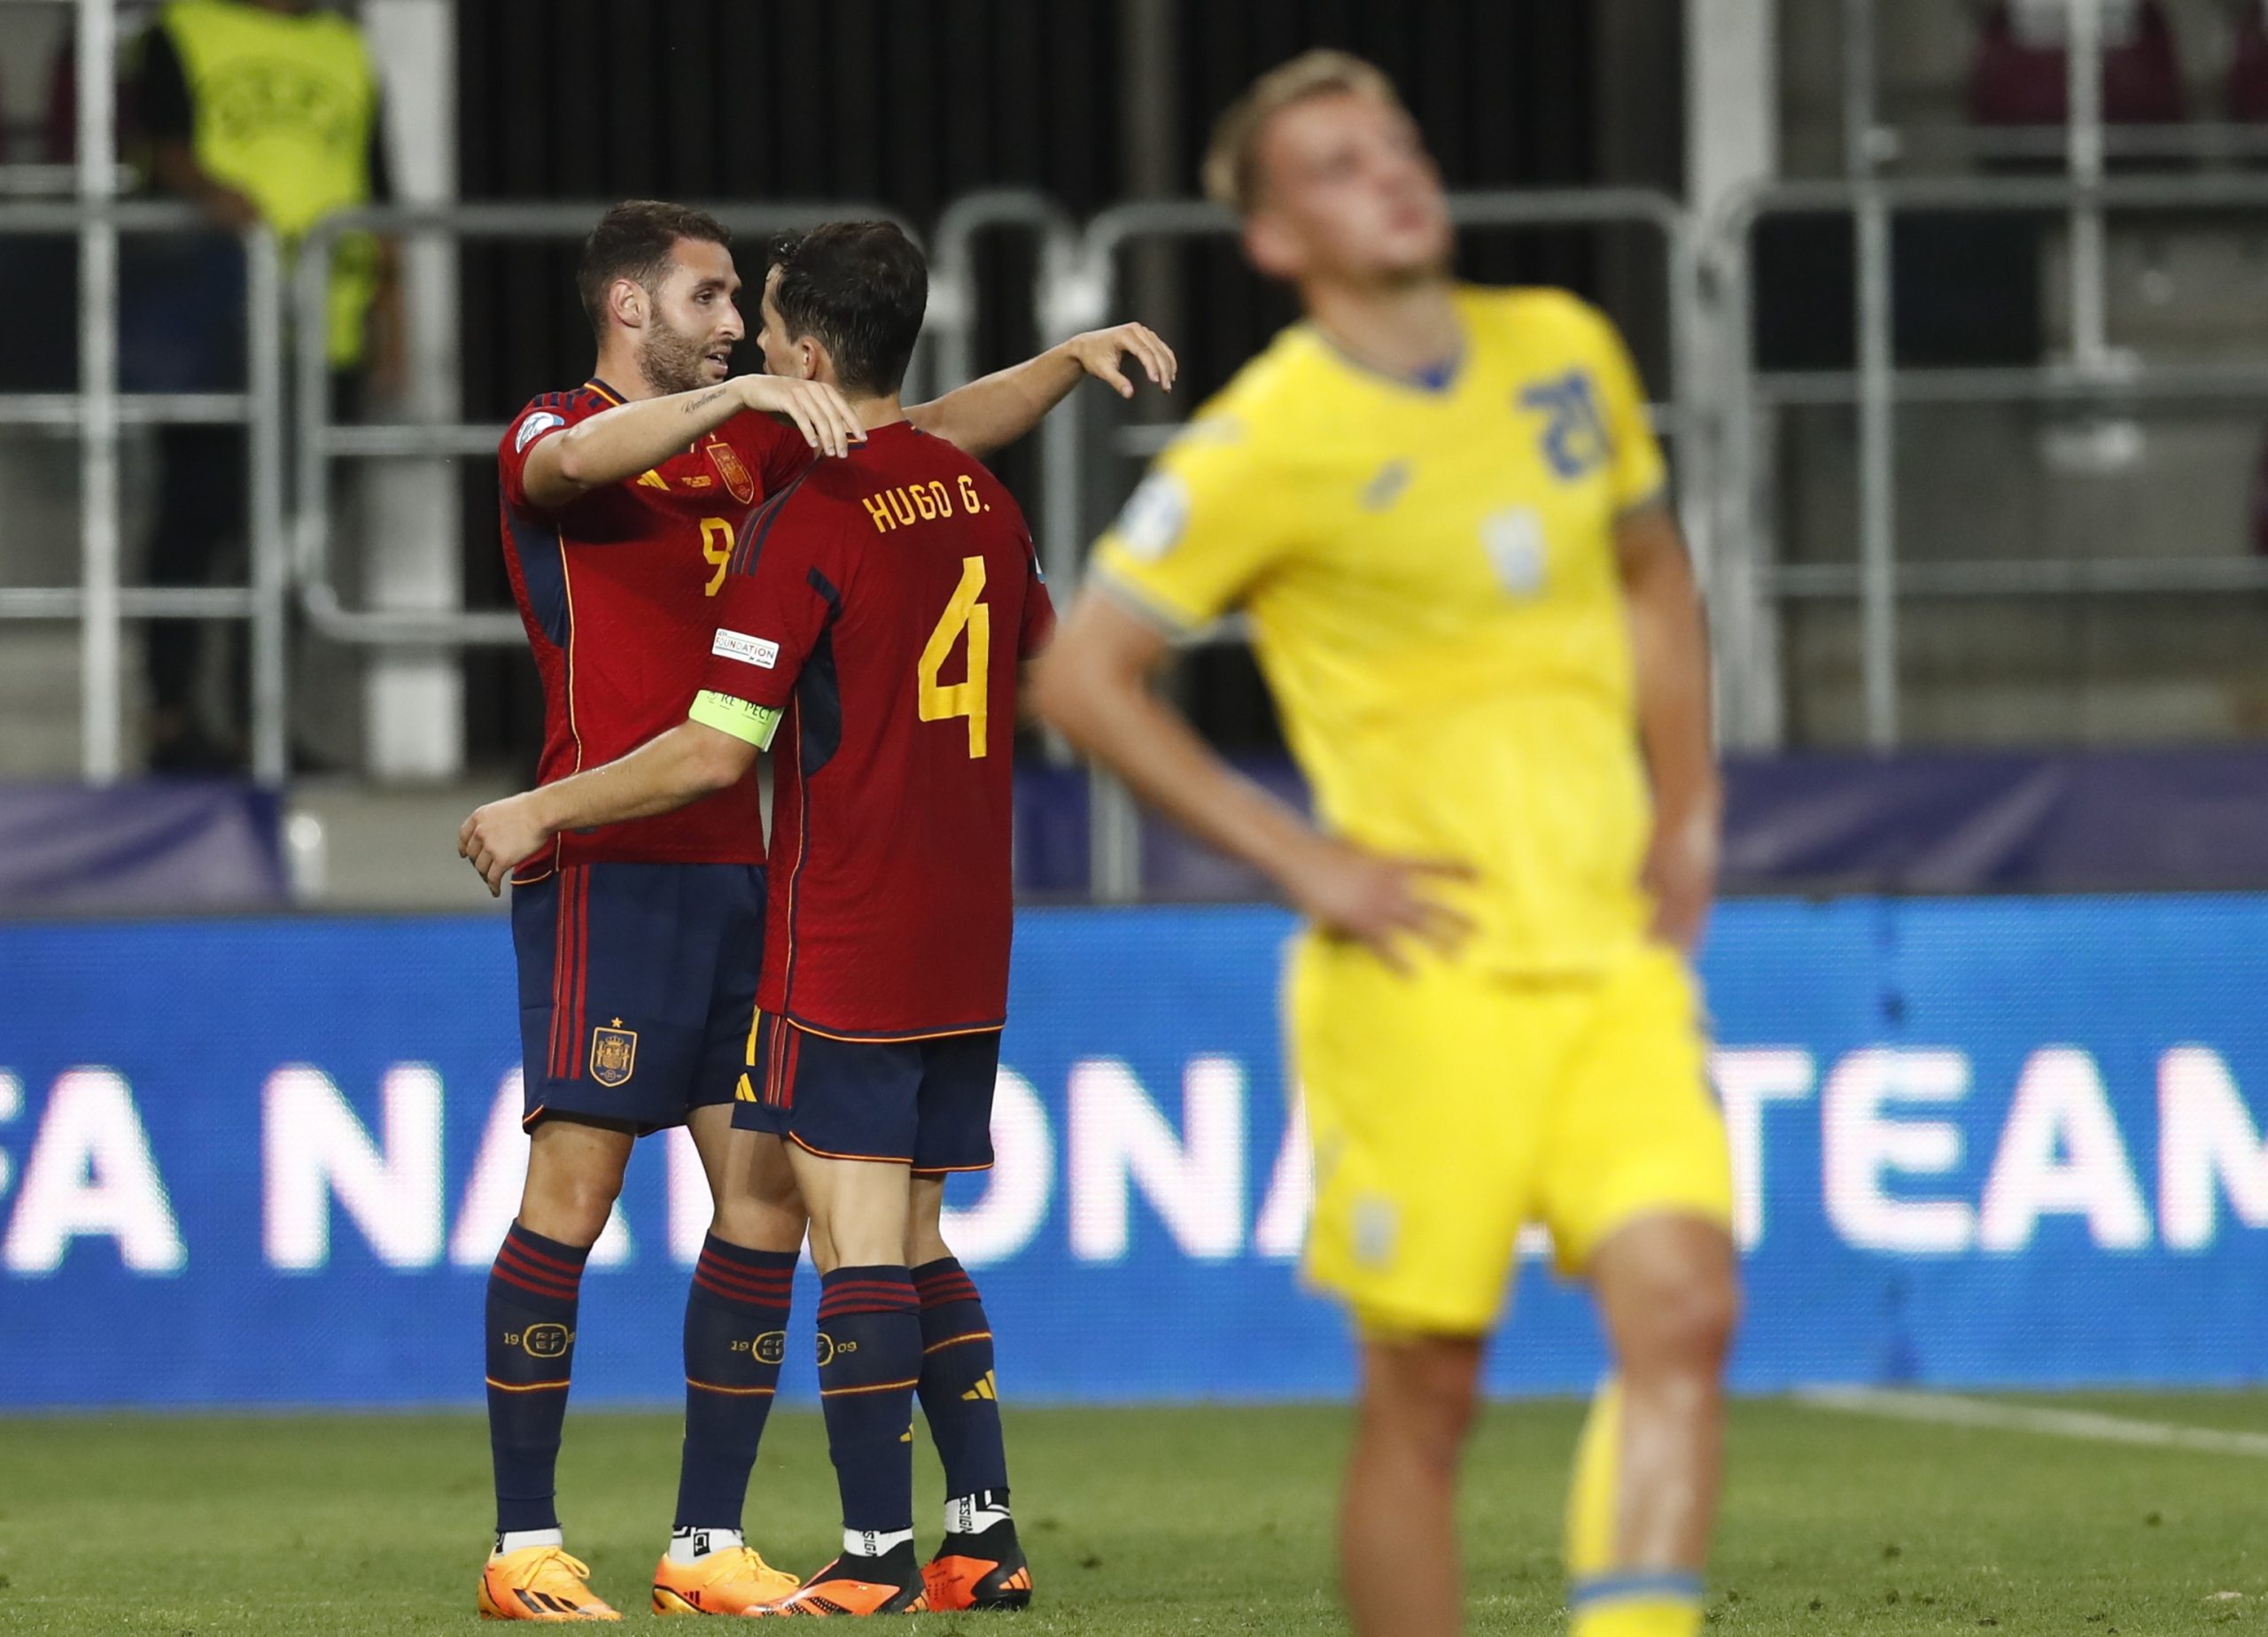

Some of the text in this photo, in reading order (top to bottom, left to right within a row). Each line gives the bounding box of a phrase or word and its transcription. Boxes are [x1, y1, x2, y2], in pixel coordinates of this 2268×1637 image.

[862, 475, 990, 533] HUGO G.
[700, 517, 734, 596] 9
[716, 637, 775, 659] FOUNDATION
[918, 555, 990, 759] 4
[720, 694, 773, 721] REPECT
[503, 1332, 519, 1345] 19
